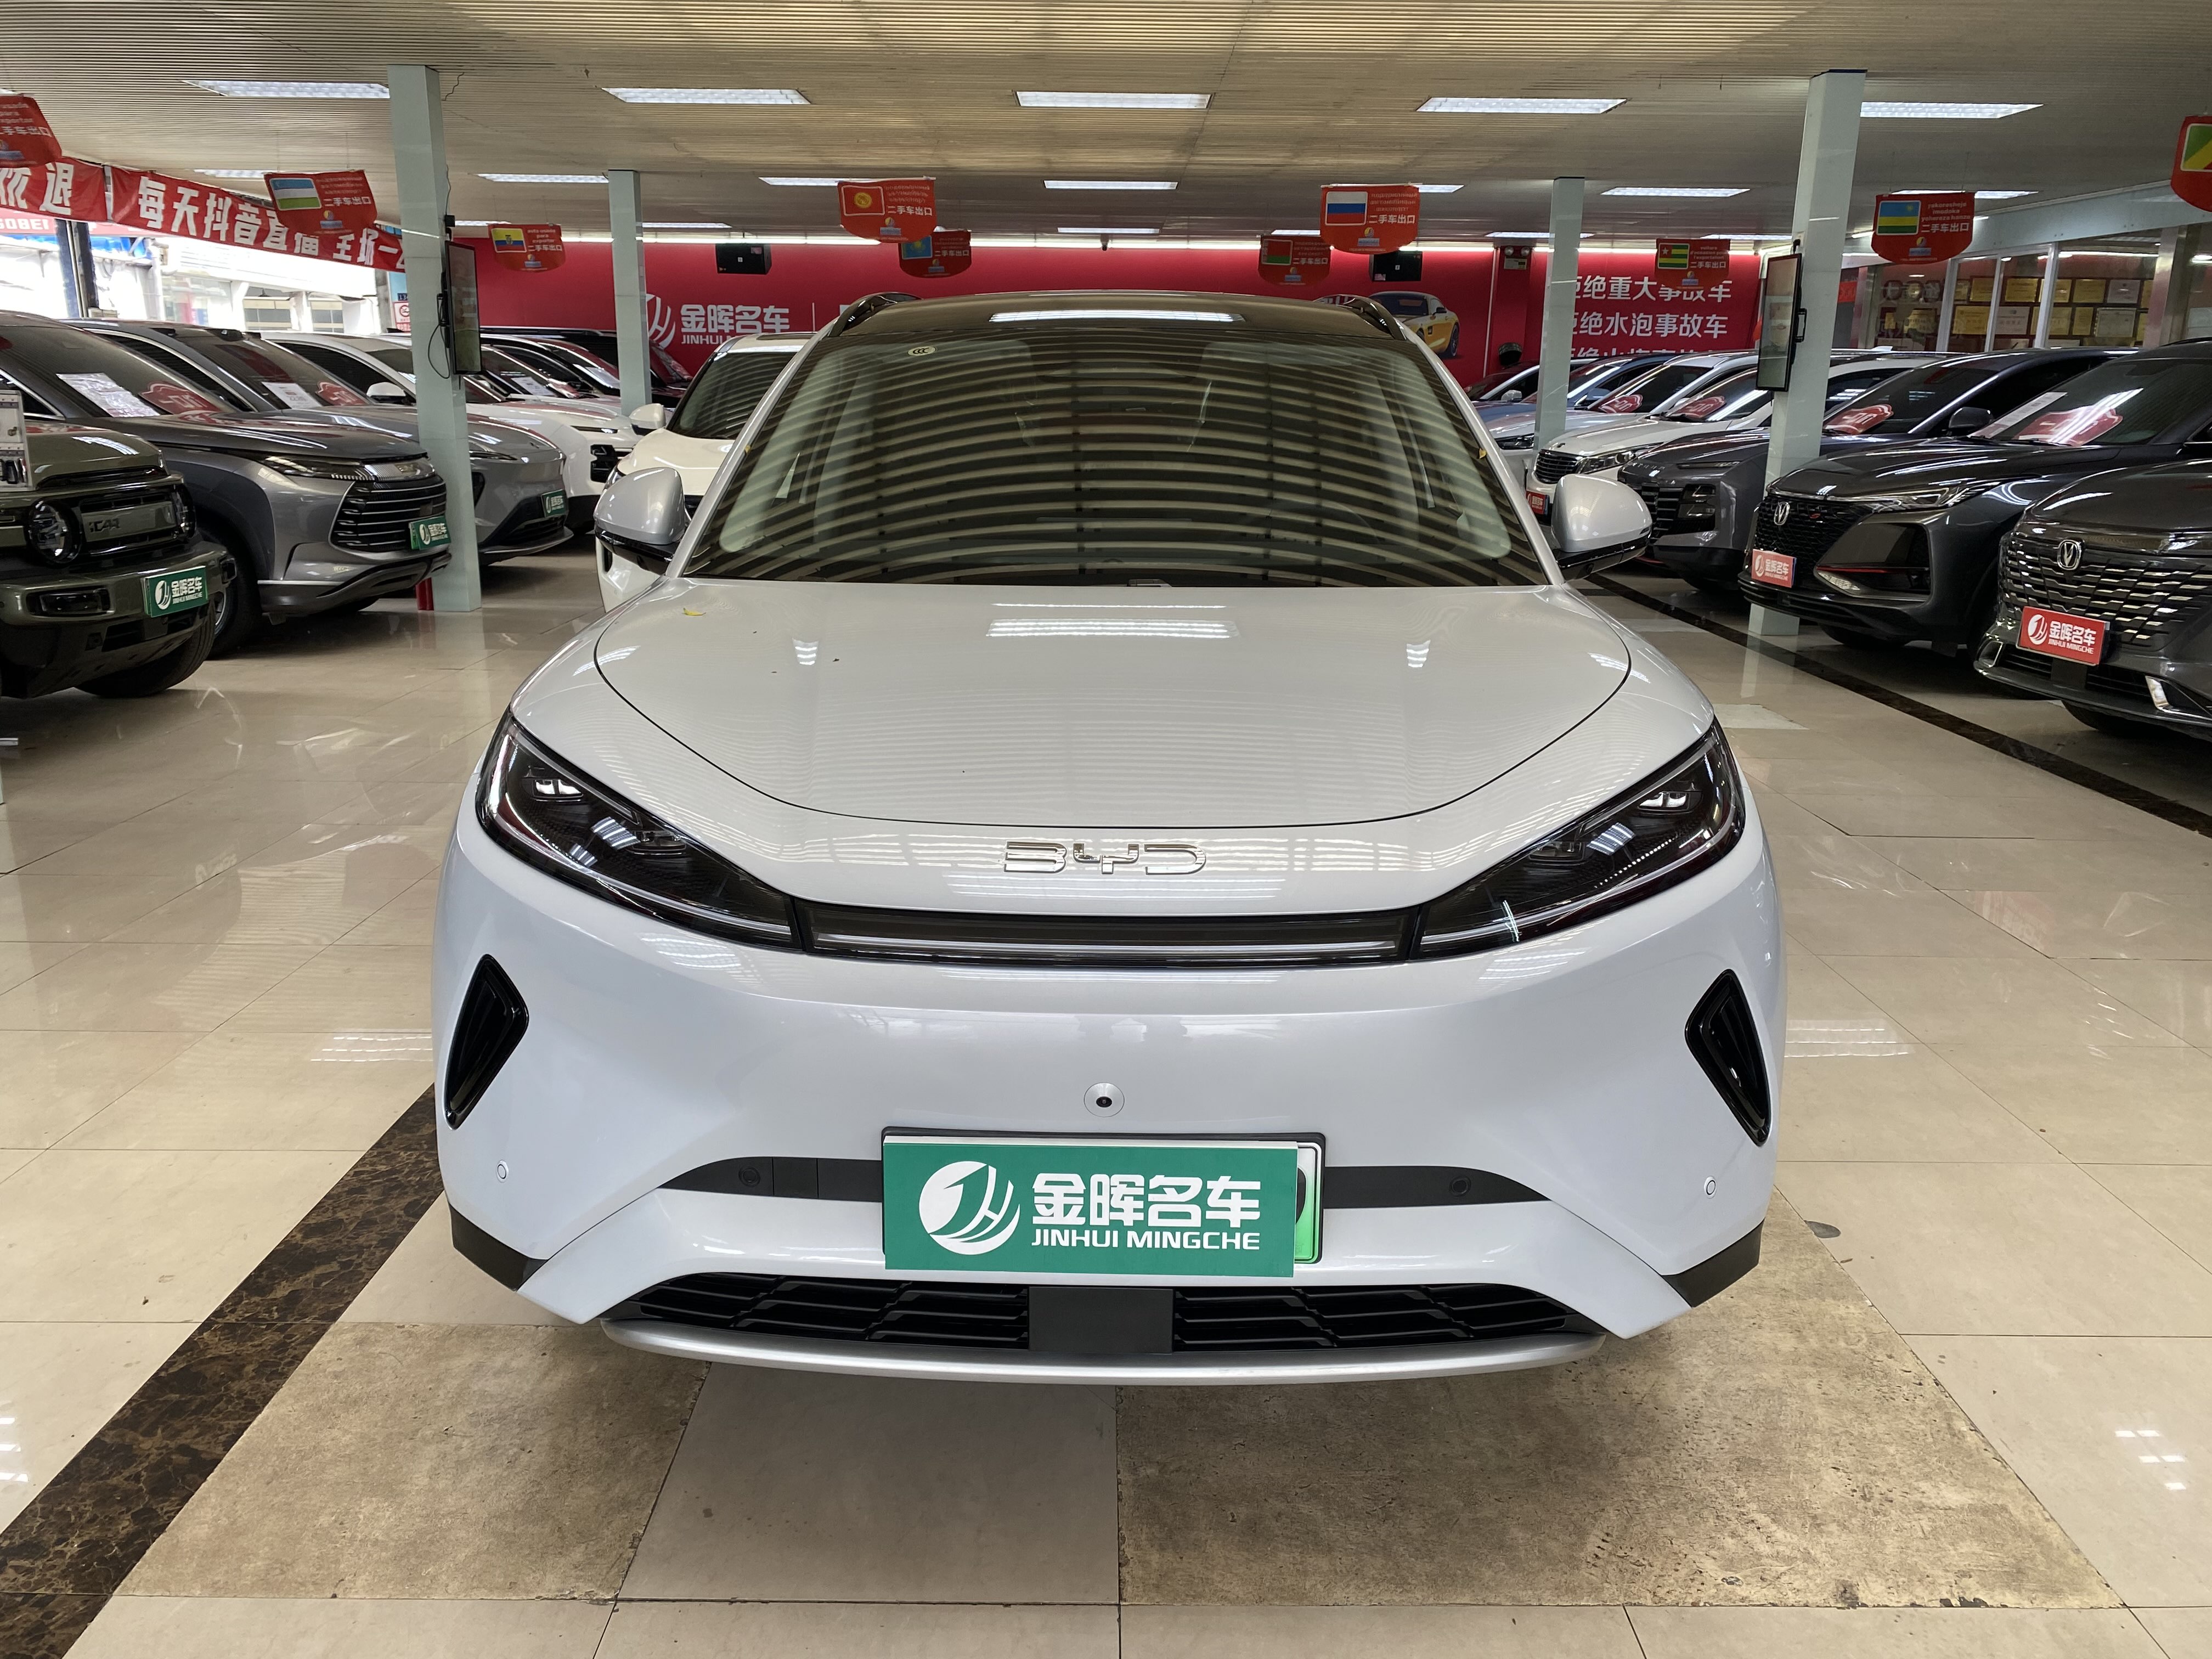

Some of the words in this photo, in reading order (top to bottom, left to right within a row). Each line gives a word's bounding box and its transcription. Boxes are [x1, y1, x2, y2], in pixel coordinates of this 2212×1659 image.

[323, 196, 372, 207] 二手车出口
[887, 205, 933, 216] 二手车出口
[1369, 215, 1415, 224] 二手车出口
[1921, 222, 1970, 233] 二手车出口
[680, 304, 790, 334] 金晖名车
[2049, 620, 2097, 646] 金晖名车
[1004, 841, 1207, 874] BYD
[1032, 1173, 1261, 1228] 金晖名车
[1031, 1229, 1119, 1248] JINHUI
[1127, 1231, 1260, 1250] MINGCHE
